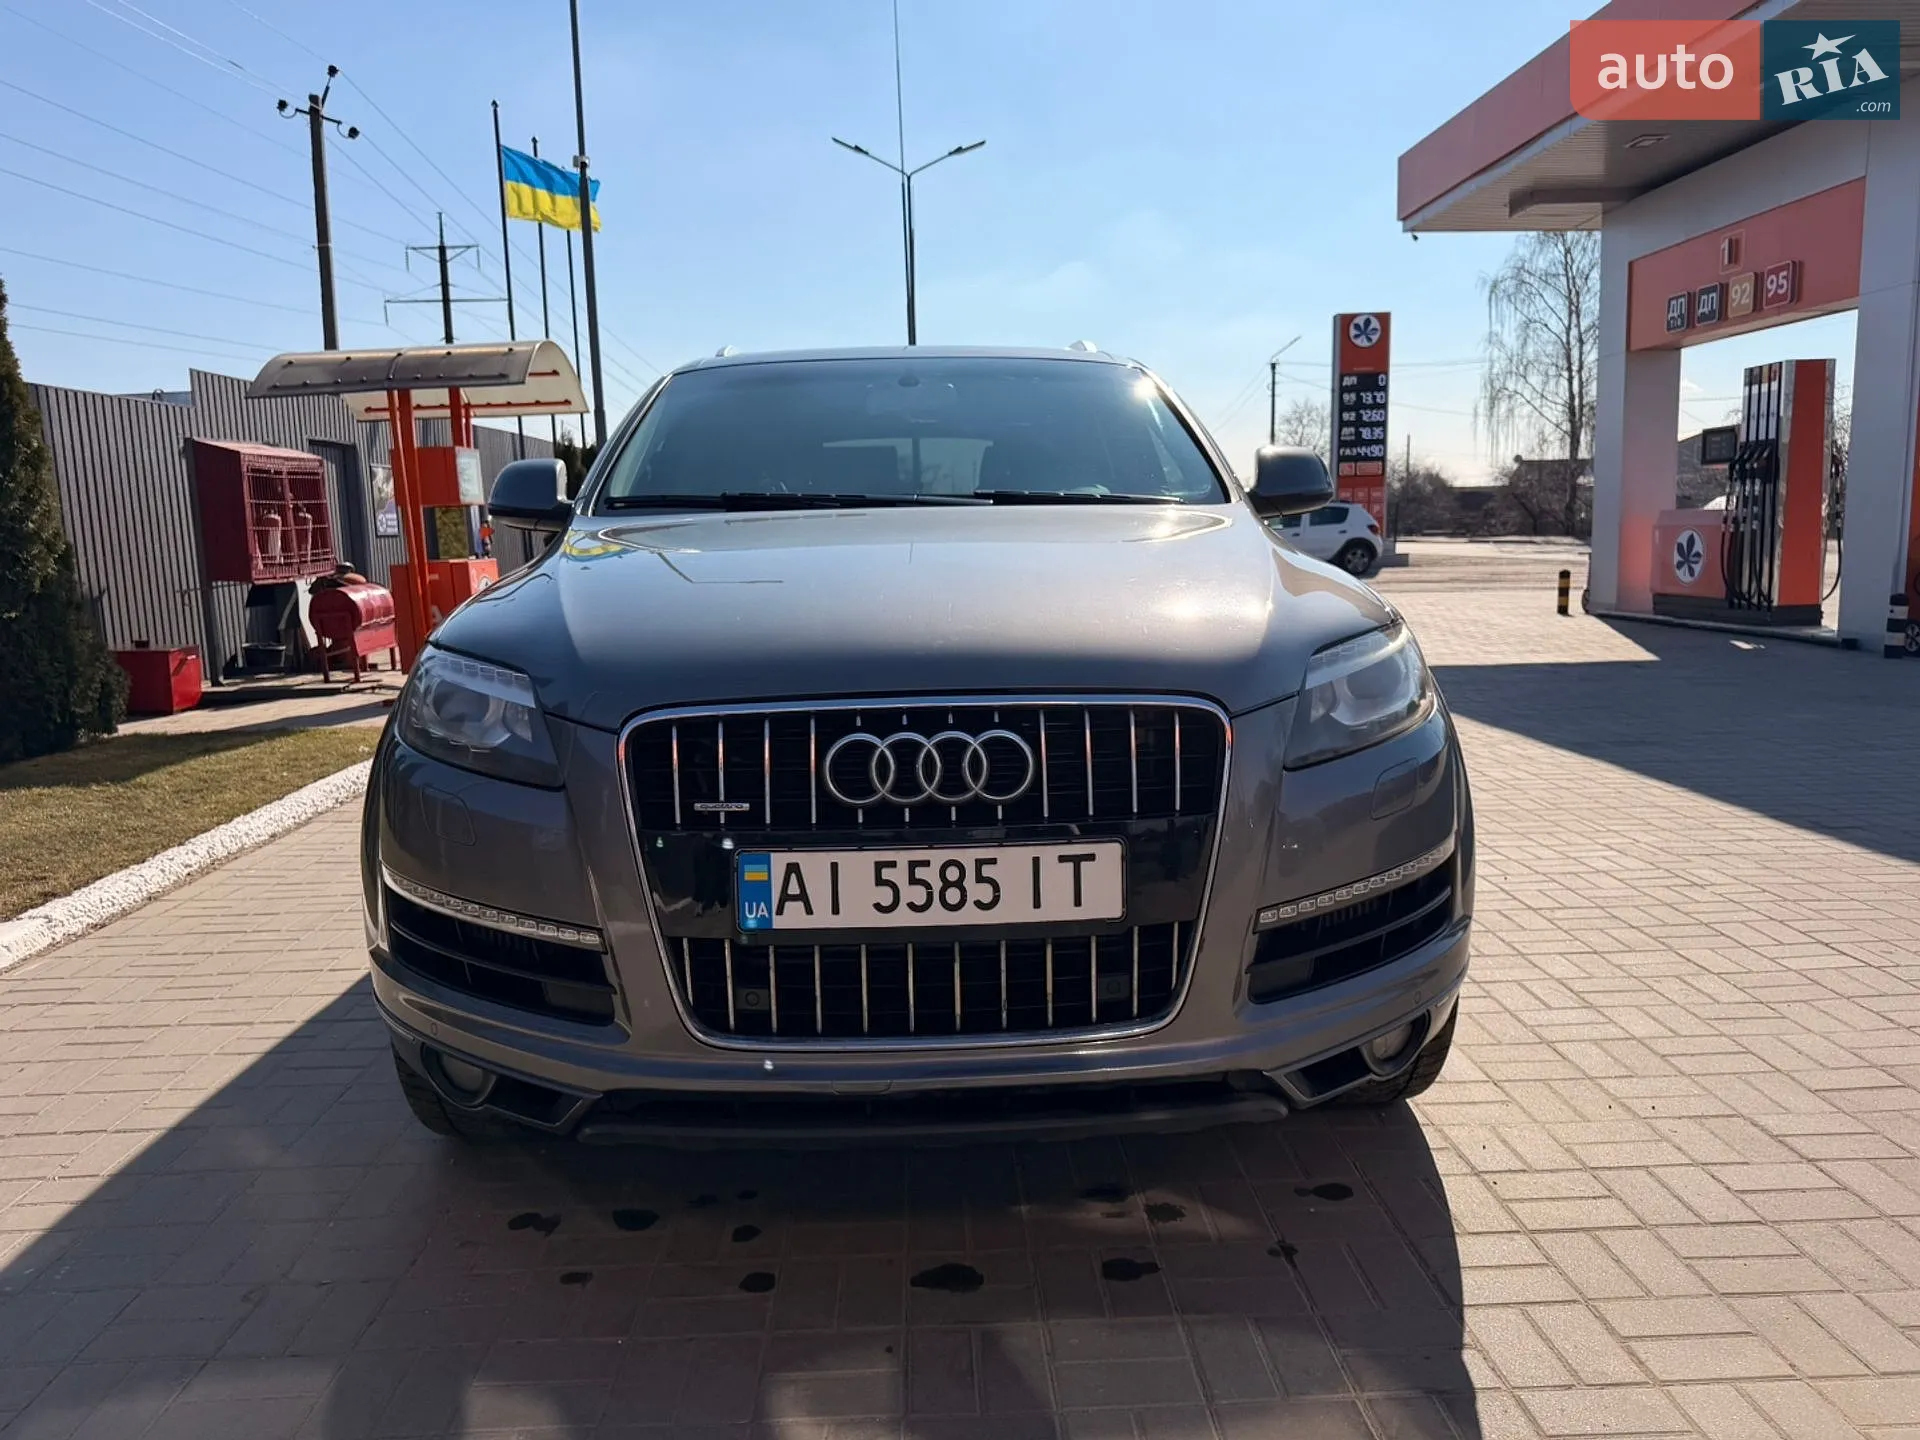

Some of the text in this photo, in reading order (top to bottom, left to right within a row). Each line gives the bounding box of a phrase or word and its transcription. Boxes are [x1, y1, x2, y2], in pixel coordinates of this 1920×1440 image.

[1668, 270, 1788, 320] ДП ДП 92 95
[1342, 374, 1386, 387] ДП 0
[1342, 411, 1356, 422] 92
[775, 853, 1097, 916] AI 5585 IT
[744, 901, 769, 918] UA
